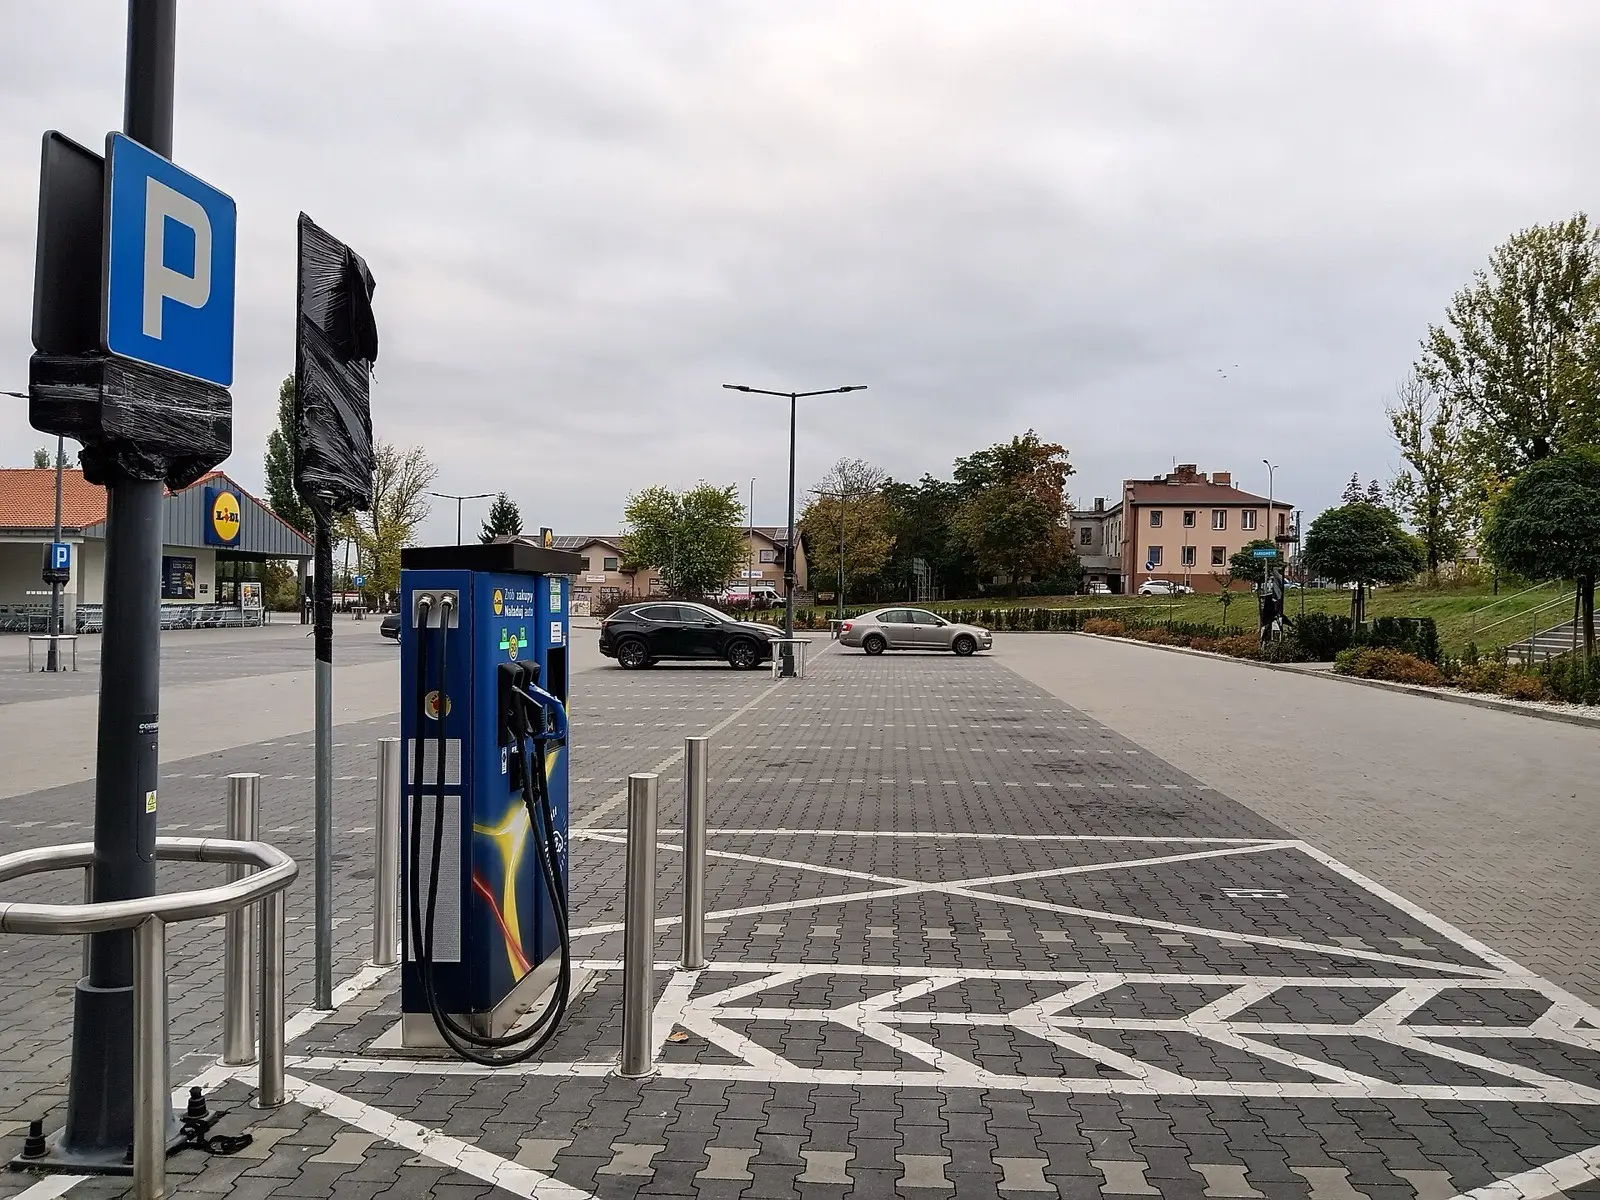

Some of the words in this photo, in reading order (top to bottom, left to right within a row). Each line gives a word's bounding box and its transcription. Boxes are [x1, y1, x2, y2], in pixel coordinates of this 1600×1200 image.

[143, 176, 212, 340] P
[56, 547, 67, 568] P
[357, 577, 363, 585] P
[504, 588, 515, 601] Zrób
[516, 589, 533, 604] zakupy
[504, 605, 524, 620] Naładuj
[524, 608, 533, 617] auto
